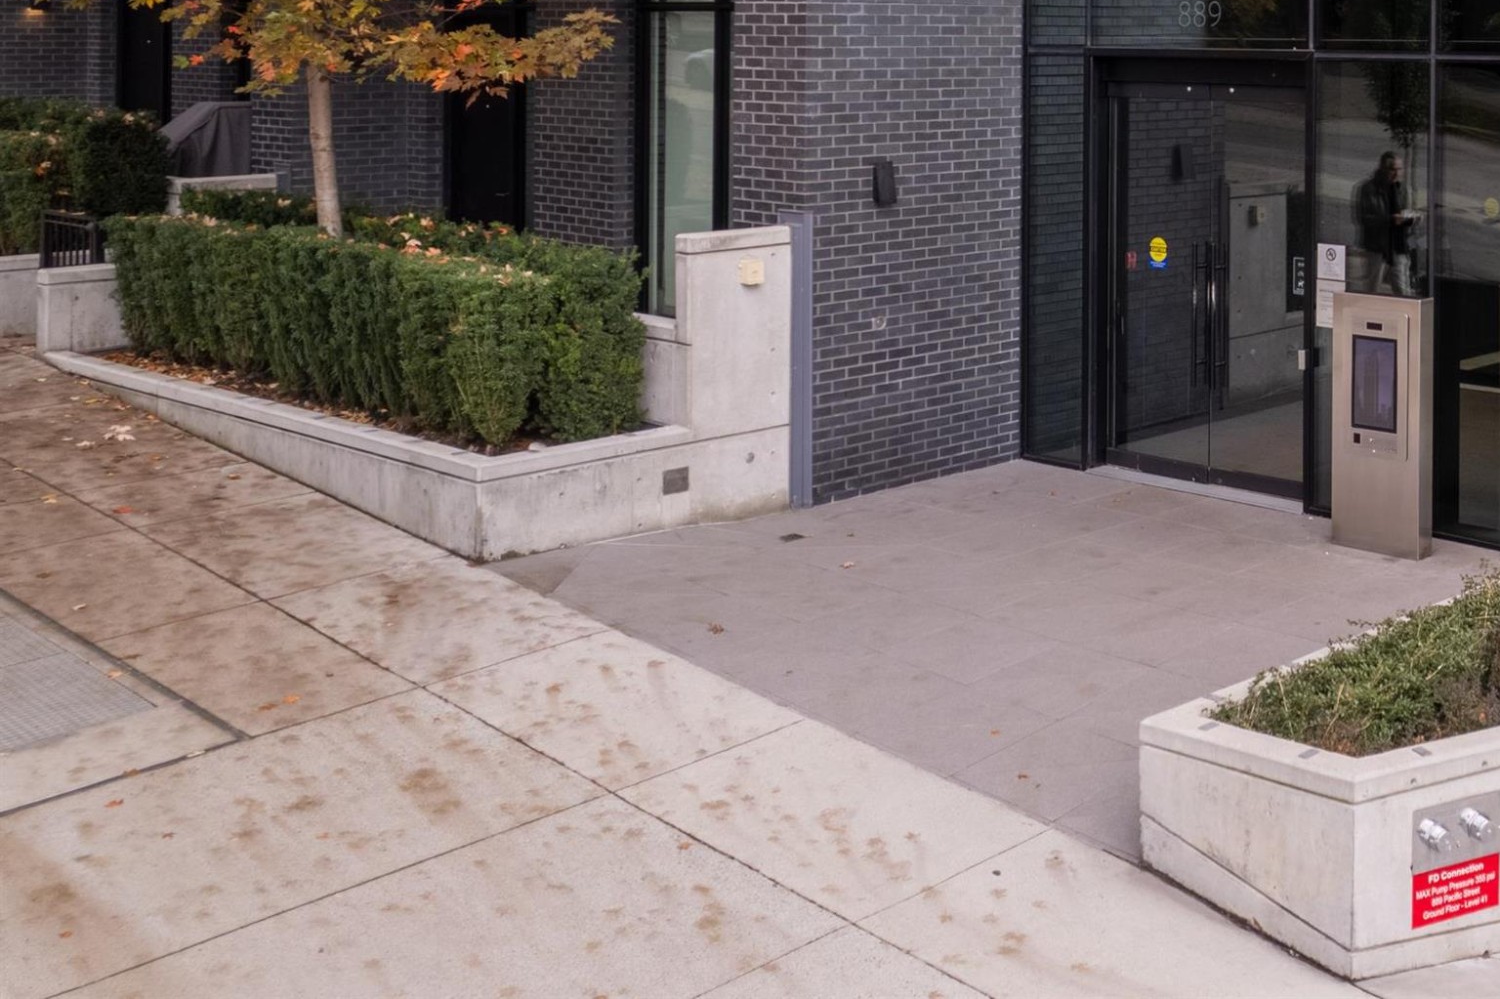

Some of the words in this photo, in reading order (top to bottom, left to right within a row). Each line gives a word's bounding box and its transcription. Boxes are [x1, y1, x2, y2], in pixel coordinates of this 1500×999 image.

[1178, 1, 1221, 27] 889
[1428, 873, 1440, 884] FD
[1440, 863, 1484, 880] Connection
[1416, 889, 1431, 900] MAX
[1431, 885, 1449, 896] Pump
[1449, 878, 1474, 890] Pressure
[1443, 892, 1462, 903] Pacific
[1462, 886, 1481, 898] Street
[1423, 906, 1444, 919] Ground
[1444, 903, 1461, 914] Floor
[1464, 897, 1480, 908] Level
